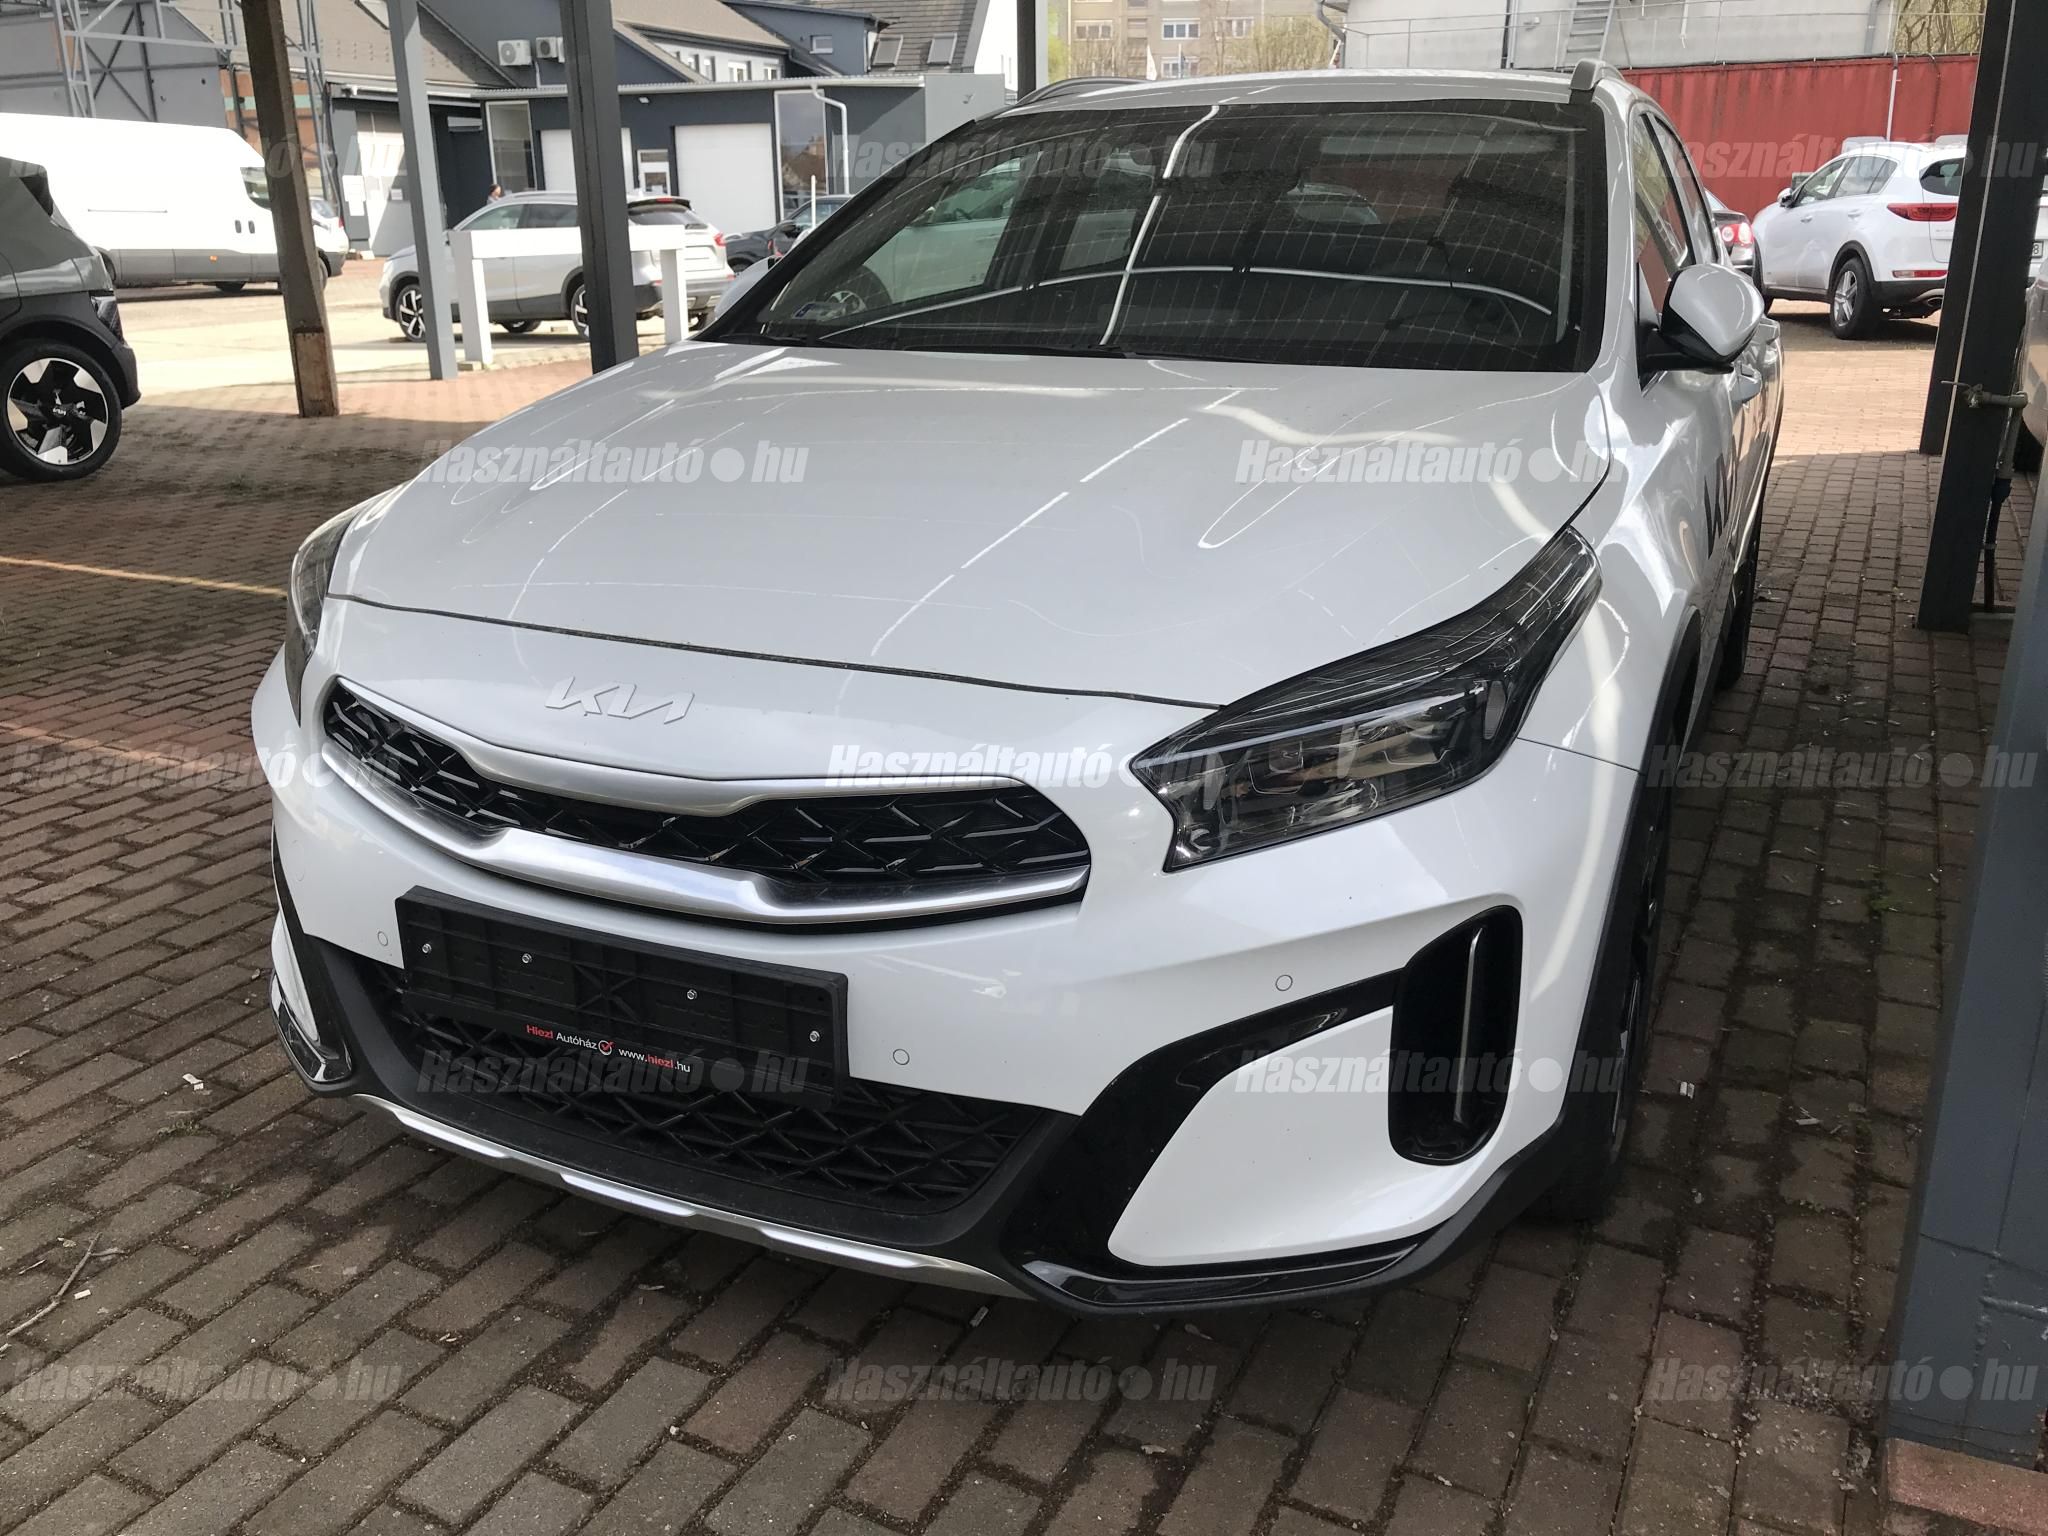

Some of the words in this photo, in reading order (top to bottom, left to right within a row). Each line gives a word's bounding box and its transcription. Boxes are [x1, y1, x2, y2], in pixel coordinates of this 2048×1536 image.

[545, 675, 696, 724] KIA
[526, 1024, 553, 1040] Hiezl
[556, 1032, 598, 1051] Autóház
[618, 1047, 691, 1073] www.hiezl.hu
